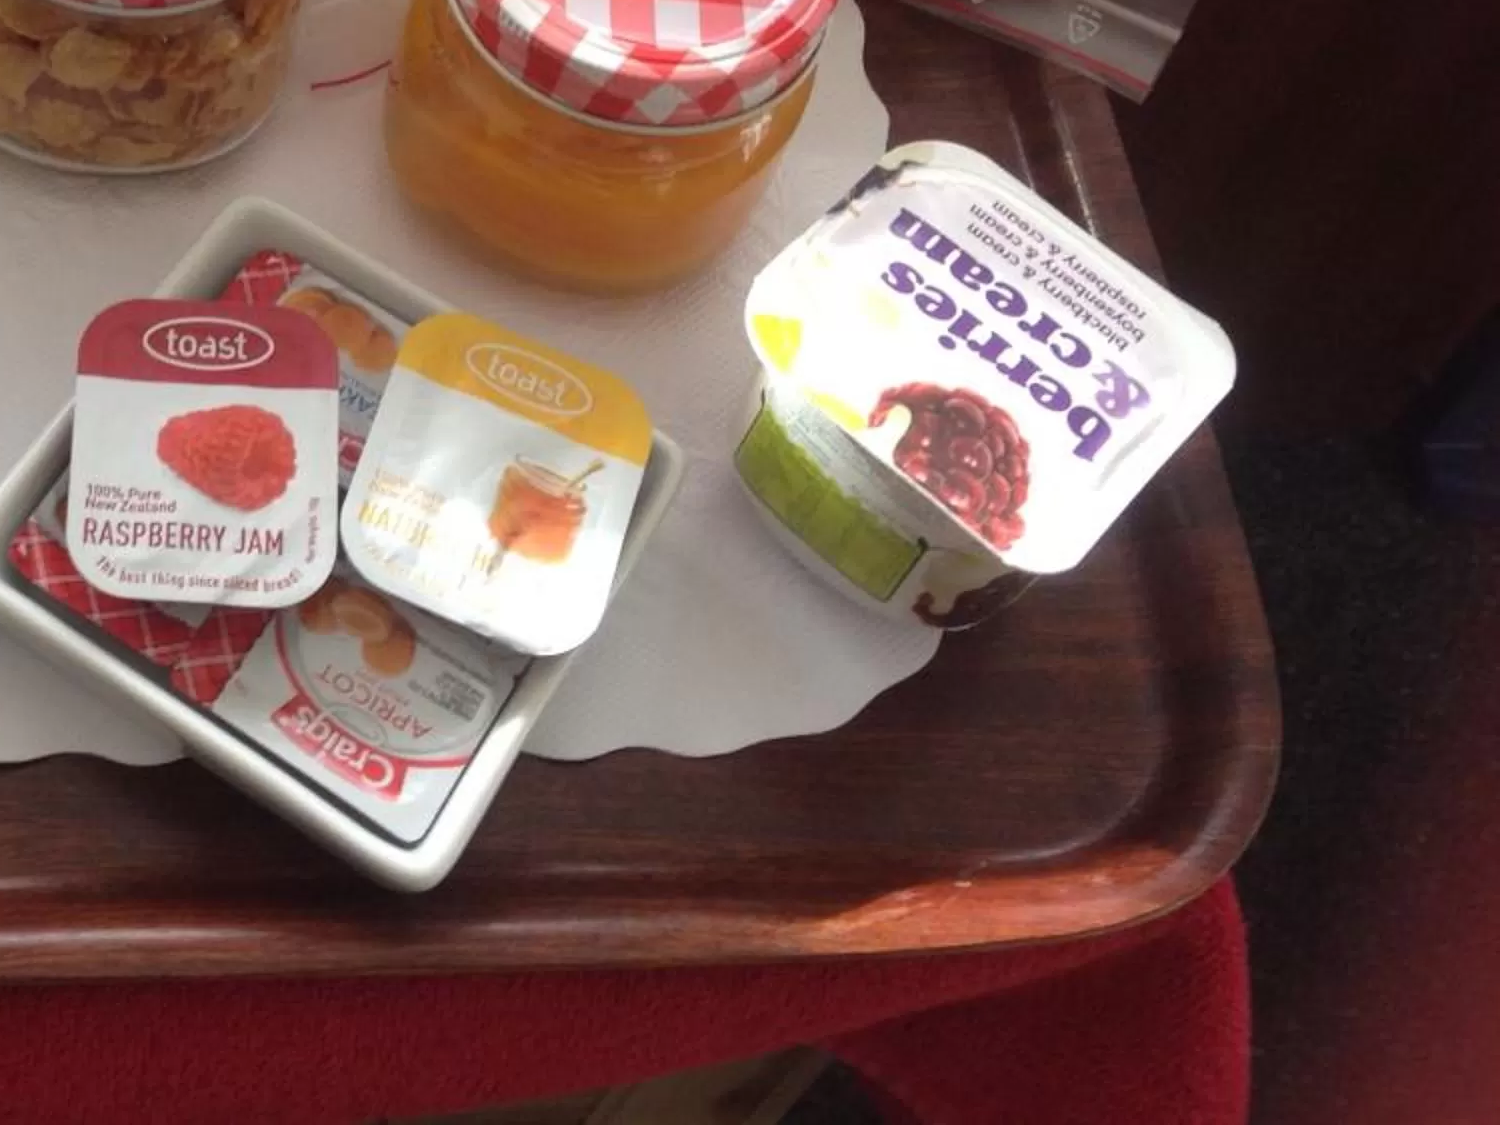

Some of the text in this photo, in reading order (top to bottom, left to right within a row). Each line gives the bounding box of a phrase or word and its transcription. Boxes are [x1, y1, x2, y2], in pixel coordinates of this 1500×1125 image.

[966, 222, 1130, 353] blackberry & cream
[969, 203, 1146, 344] boysenberry & cream
[991, 199, 1147, 321] raspberry & cream
[165, 326, 250, 361] toast
[888, 206, 1151, 420] & cream
[485, 351, 567, 408] toast
[880, 261, 1113, 463] berries
[83, 497, 177, 514] New Zealand
[127, 486, 162, 501] Pure
[82, 517, 227, 553] RASPBERRY
[233, 527, 285, 557] JAM
[151, 570, 185, 589] thing
[188, 574, 220, 589] since
[314, 663, 433, 740] APRICOT
[292, 704, 396, 789] Craig's
